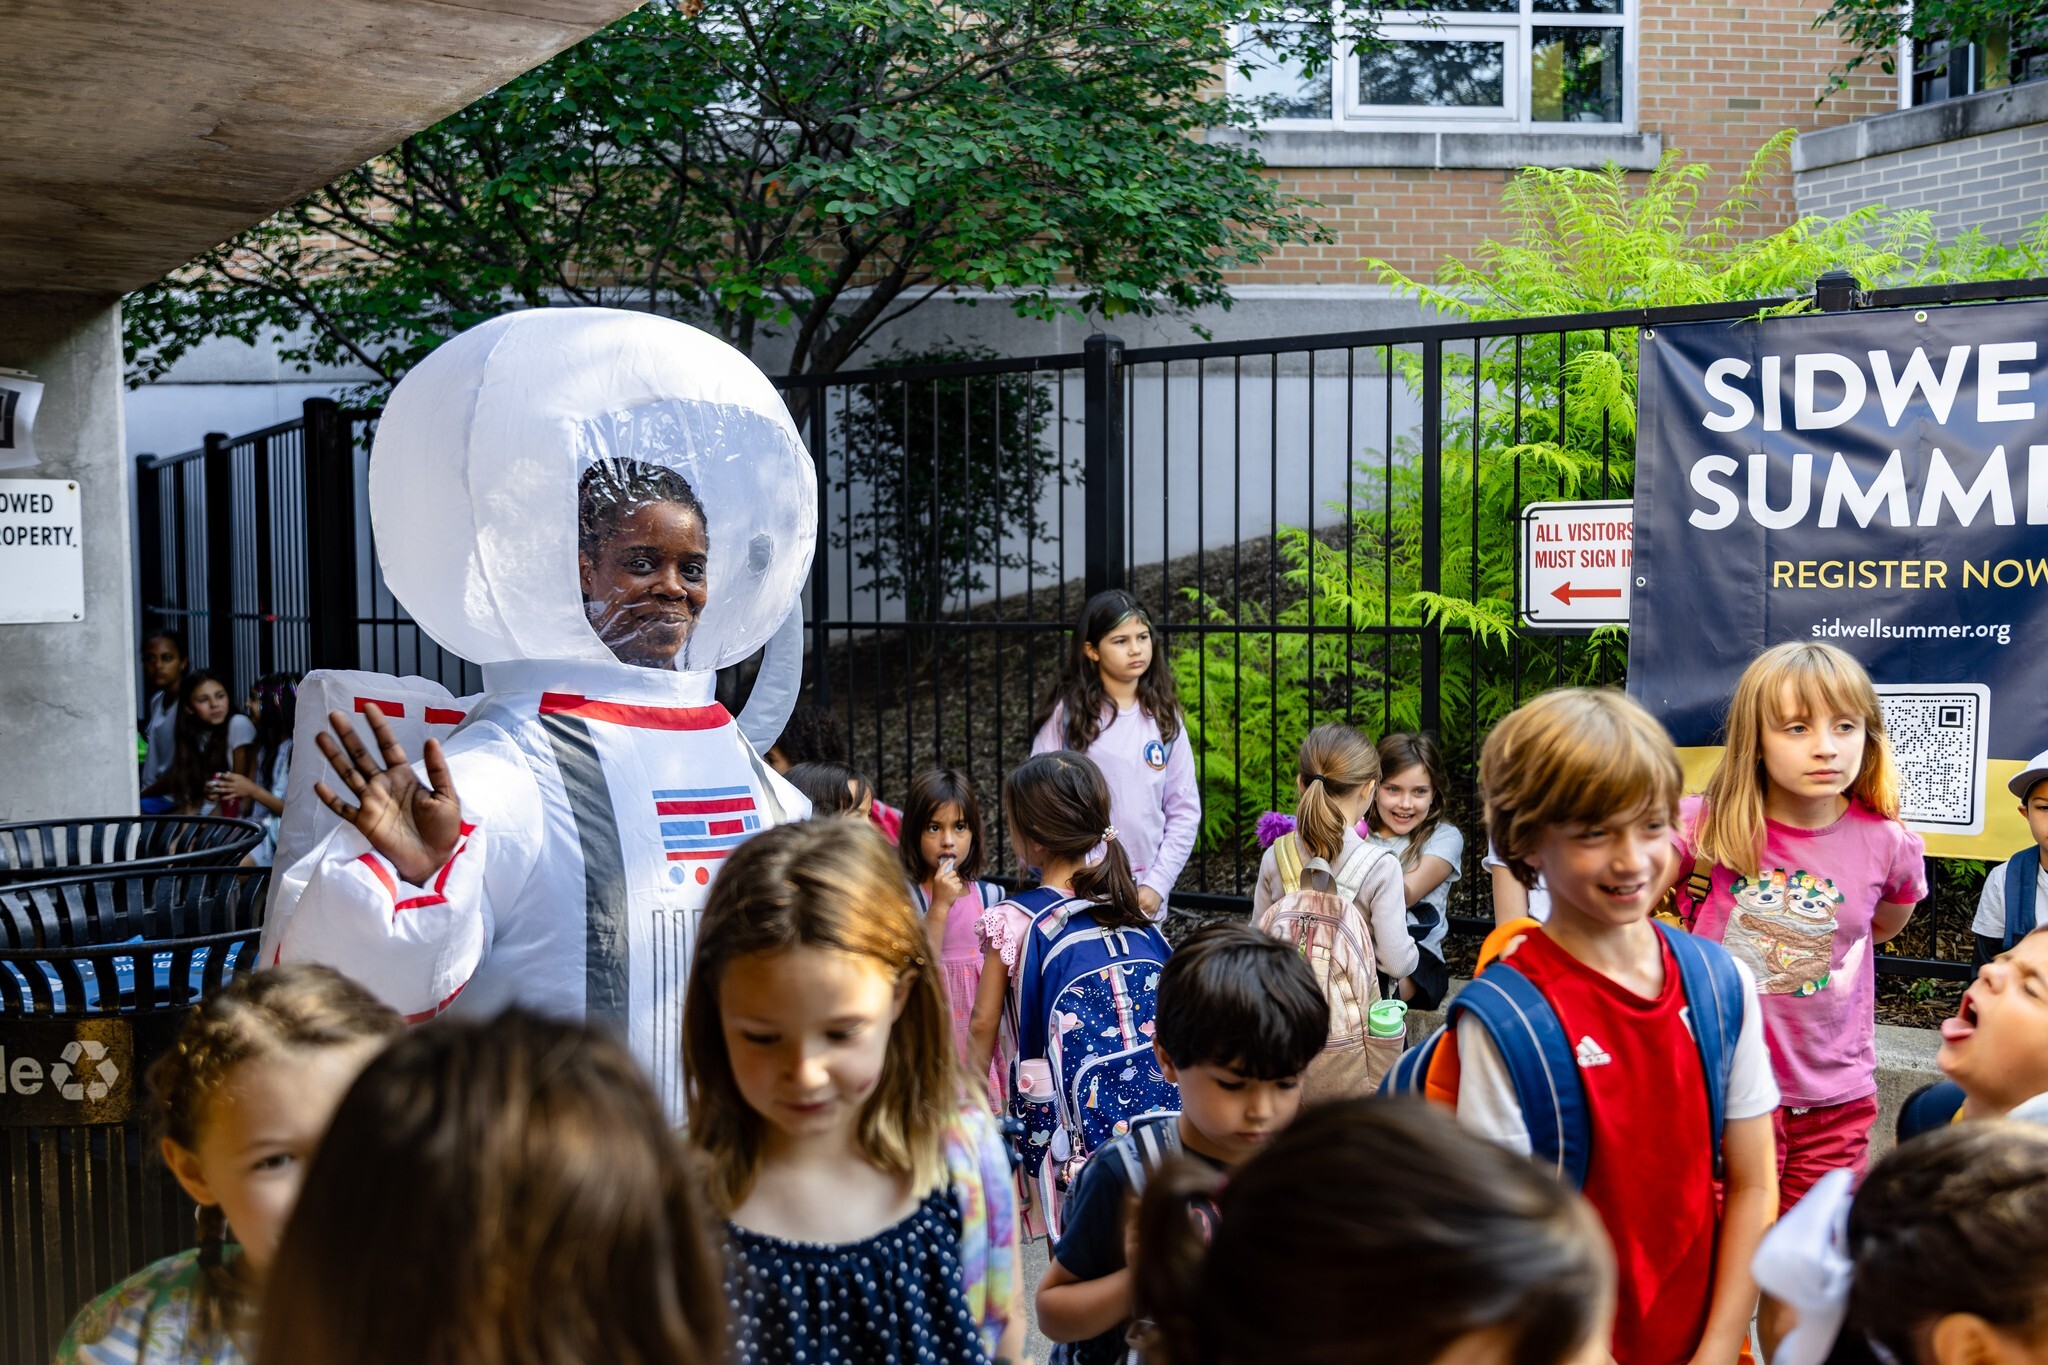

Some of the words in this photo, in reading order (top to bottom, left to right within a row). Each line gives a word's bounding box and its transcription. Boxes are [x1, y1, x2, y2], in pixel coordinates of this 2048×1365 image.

[1702, 341, 2037, 433] SIDWE
[0, 492, 53, 514] OWED
[1535, 524, 1563, 542] ALL
[1568, 522, 1633, 541] VISITORS
[1535, 550, 1576, 568] MUST
[1580, 549, 1616, 568] SIGN
[1773, 560, 1947, 589] REGISTER
[1811, 618, 2011, 645] sidwellsummer.org
